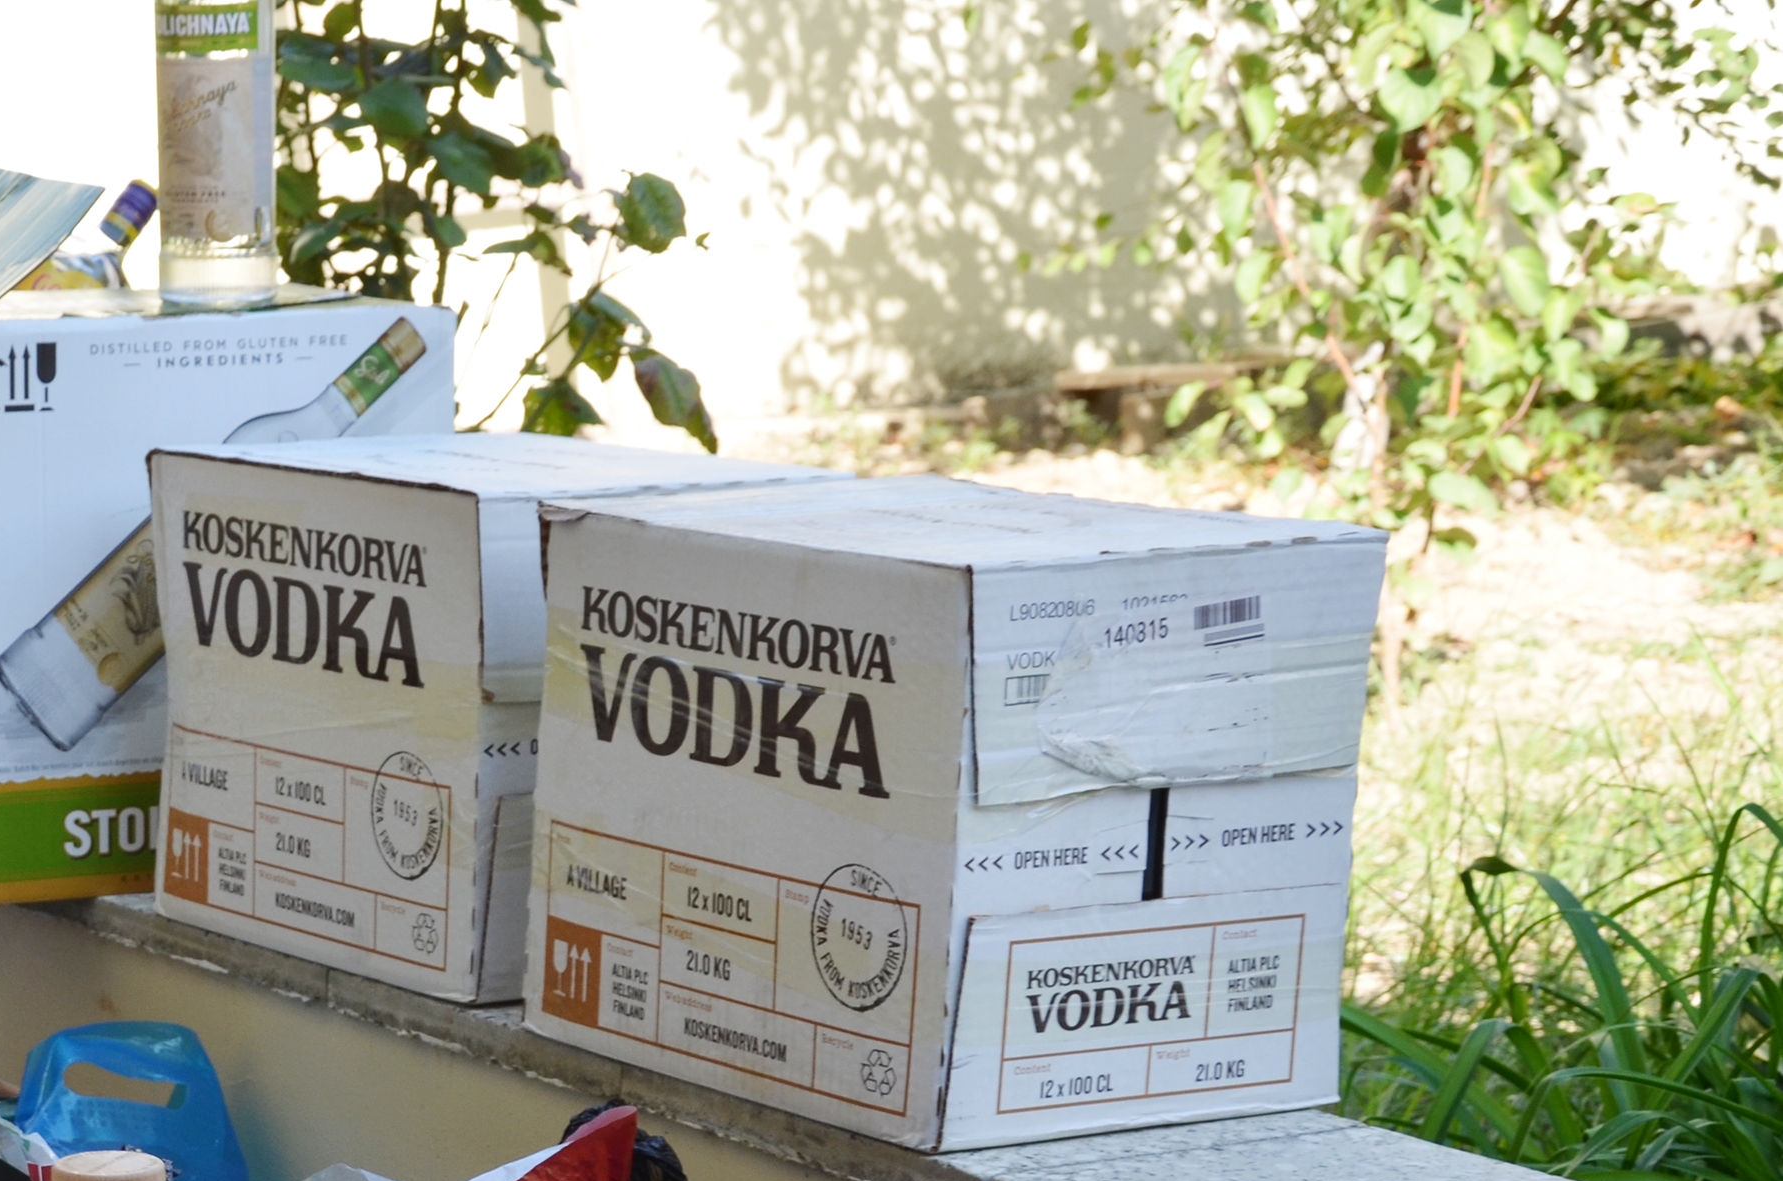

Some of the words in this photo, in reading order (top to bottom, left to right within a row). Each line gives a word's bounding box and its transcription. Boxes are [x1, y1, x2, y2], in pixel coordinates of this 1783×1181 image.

[90, 340, 173, 356] DISTILLED
[183, 338, 226, 352] FROM
[238, 336, 299, 349] GLUTEN
[309, 334, 348, 347] FREE
[157, 353, 285, 369] INGREDIENTS
[183, 510, 428, 588] KOSKENKORVA
[183, 561, 425, 689] VODKA
[581, 585, 897, 685] KOSKENKORVA
[1006, 650, 1056, 671] VODK
[580, 644, 891, 800] VODKA
[188, 762, 229, 792] VILLAGE
[275, 776, 286, 797] 12
[295, 780, 311, 802] 100
[314, 785, 327, 806] CL
[393, 799, 418, 828] 1953
[276, 832, 295, 855] 21.0
[297, 838, 311, 859] KG
[1222, 827, 1258, 848] OPEN
[1261, 823, 1296, 845] HERE
[1014, 850, 1050, 870] OPEN
[1053, 846, 1088, 867] HERE
[567, 865, 575, 886] A
[576, 866, 627, 900] VILLAGE
[850, 869, 883, 897] SINCE
[274, 891, 356, 928] KOSKENKORVA.COM
[687, 886, 700, 909] 12
[712, 893, 733, 918] 100
[737, 898, 752, 922] CL
[817, 899, 834, 946] VODKA
[841, 918, 873, 950] 1953
[612, 963, 632, 981] ALTIA
[634, 969, 648, 986] PLC
[686, 950, 710, 975] 21.0
[713, 959, 731, 981] KG
[820, 951, 845, 991] FROM
[847, 928, 902, 1001] KOSKENKORVA
[1026, 956, 1195, 990] KOSKENKORVA
[1228, 957, 1258, 974] ALTIA
[1260, 955, 1280, 971] PLC
[612, 981, 647, 1003] HELSINKI
[1227, 975, 1277, 994] HELSINKI
[613, 1000, 645, 1021] FINLAND
[1026, 980, 1191, 1034] VODKA
[1227, 994, 1274, 1013] FINLAND
[684, 1016, 787, 1062] KOSKENKORVA.COM
[1195, 1062, 1223, 1083] 21.0
[1226, 1059, 1246, 1080] KG
[1040, 1080, 1053, 1099] 12
[1057, 1084, 1065, 1097] x
[1068, 1076, 1093, 1097] 100
[1096, 1074, 1113, 1093] CL
